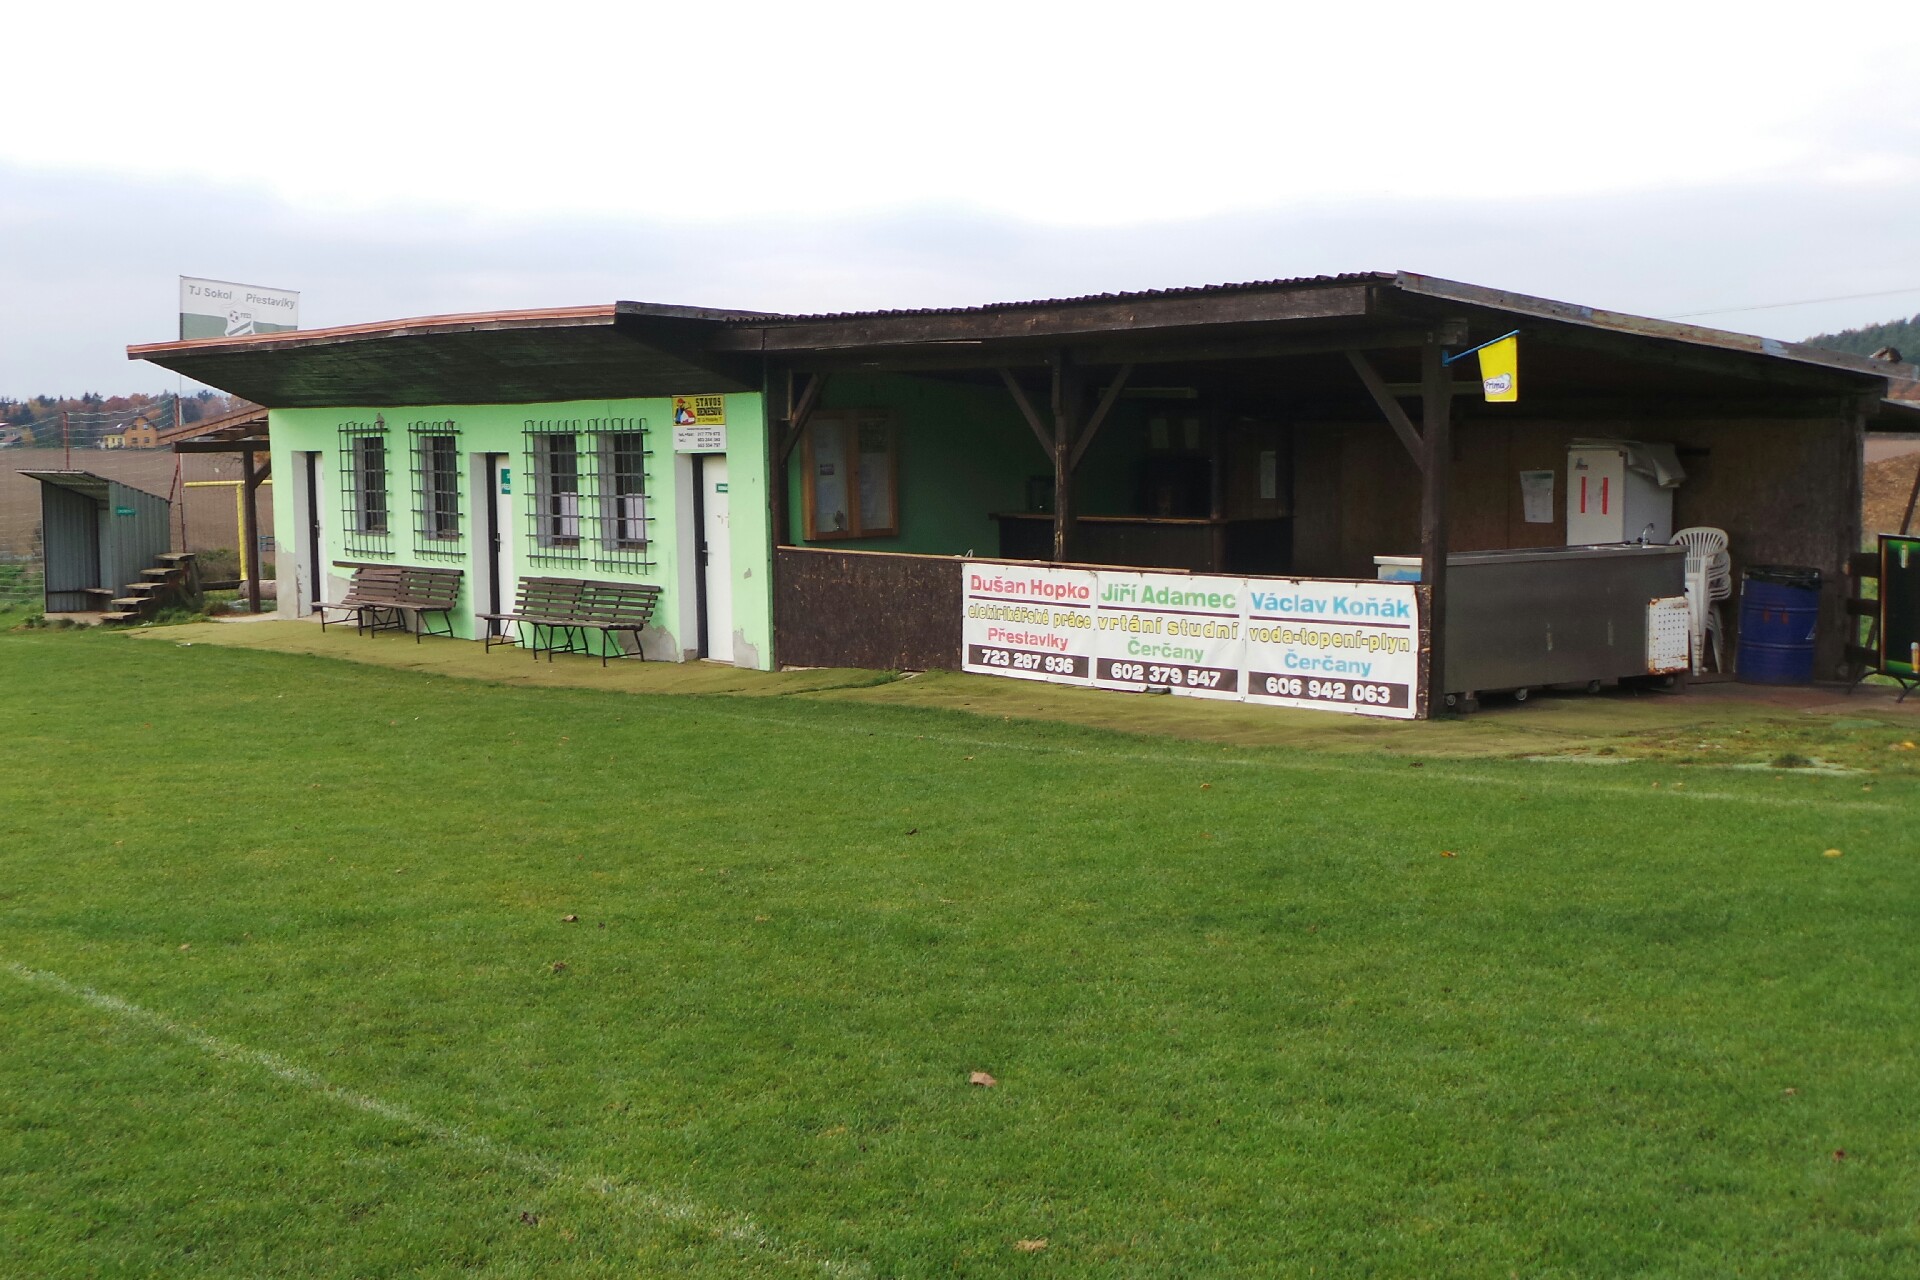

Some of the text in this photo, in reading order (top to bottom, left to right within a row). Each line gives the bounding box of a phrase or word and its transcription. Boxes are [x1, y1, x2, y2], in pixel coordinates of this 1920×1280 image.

[189, 285, 295, 309] TJ Sokol Přestavlky
[1485, 381, 1505, 390] Prima
[970, 574, 1090, 600] Dušan Hopko
[1101, 582, 1236, 609] Jiří Adamec
[968, 602, 1092, 629] elektrikářské práce
[1250, 591, 1411, 618] Václav Koňák
[988, 627, 1068, 651] Přestavlky
[1097, 614, 1240, 640] vrtání studní
[1249, 625, 1411, 654] voda-topení-plyn
[981, 648, 1074, 674] 723 287 936
[1127, 636, 1204, 663] Čerčany
[1284, 648, 1372, 677] Čerčany
[1111, 662, 1221, 688] 602 379 547
[1265, 676, 1391, 704] 606 942 063
